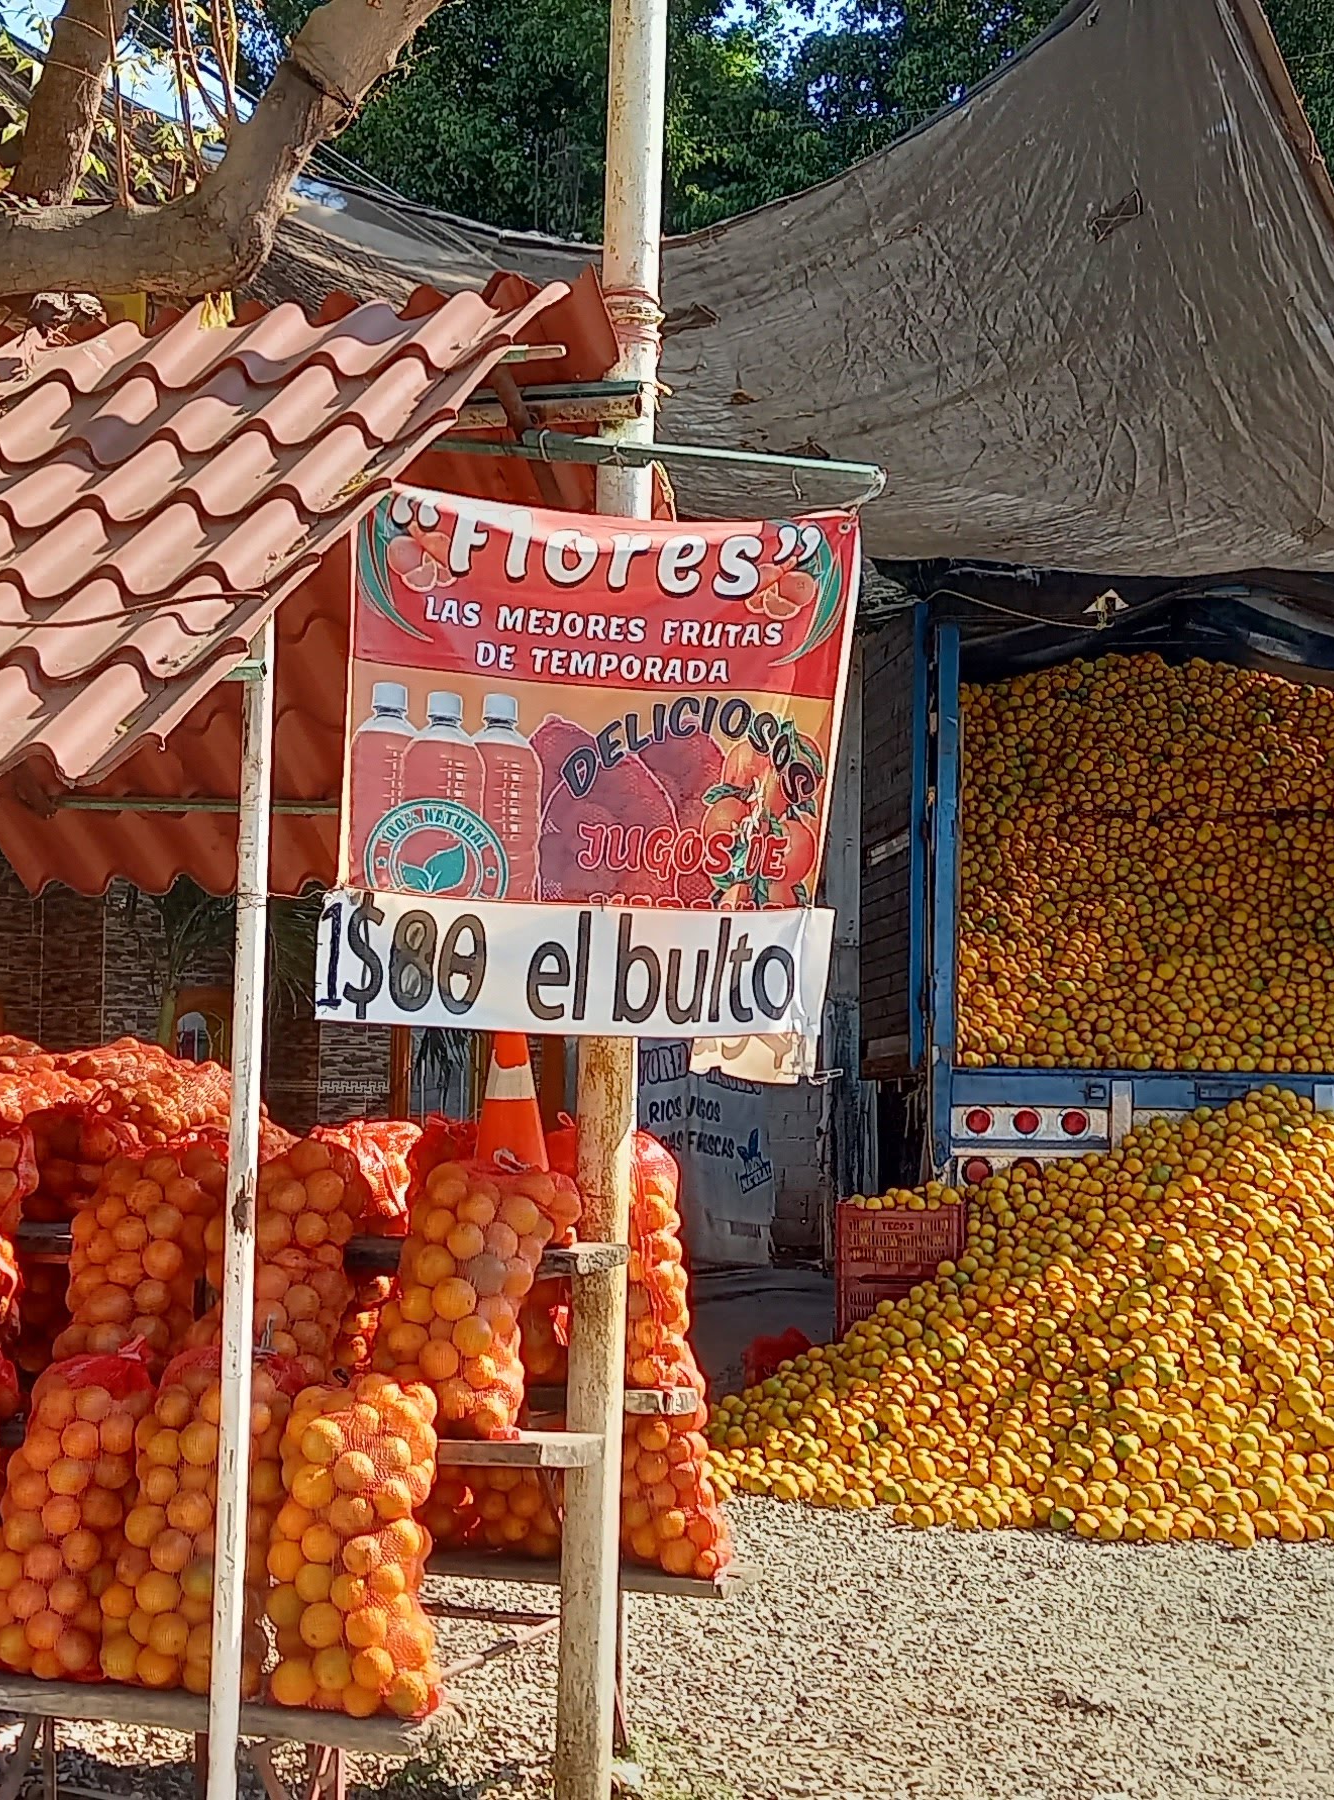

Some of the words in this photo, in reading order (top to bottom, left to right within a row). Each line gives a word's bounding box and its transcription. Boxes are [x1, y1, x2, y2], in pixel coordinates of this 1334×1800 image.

[424, 595, 481, 629] LAS
[497, 606, 646, 644] MEJORES
[662, 620, 784, 648] FRUTAS
[476, 641, 514, 672] DE
[531, 648, 730, 684] TEMPORADA
[561, 696, 816, 804] DELICIOSOS
[381, 811, 419, 844] 100%
[423, 808, 489, 851] NATURAL
[577, 823, 737, 880] JUGOS
[745, 833, 789, 879] DE
[526, 911, 591, 1021] el
[612, 914, 796, 1026] bulto
